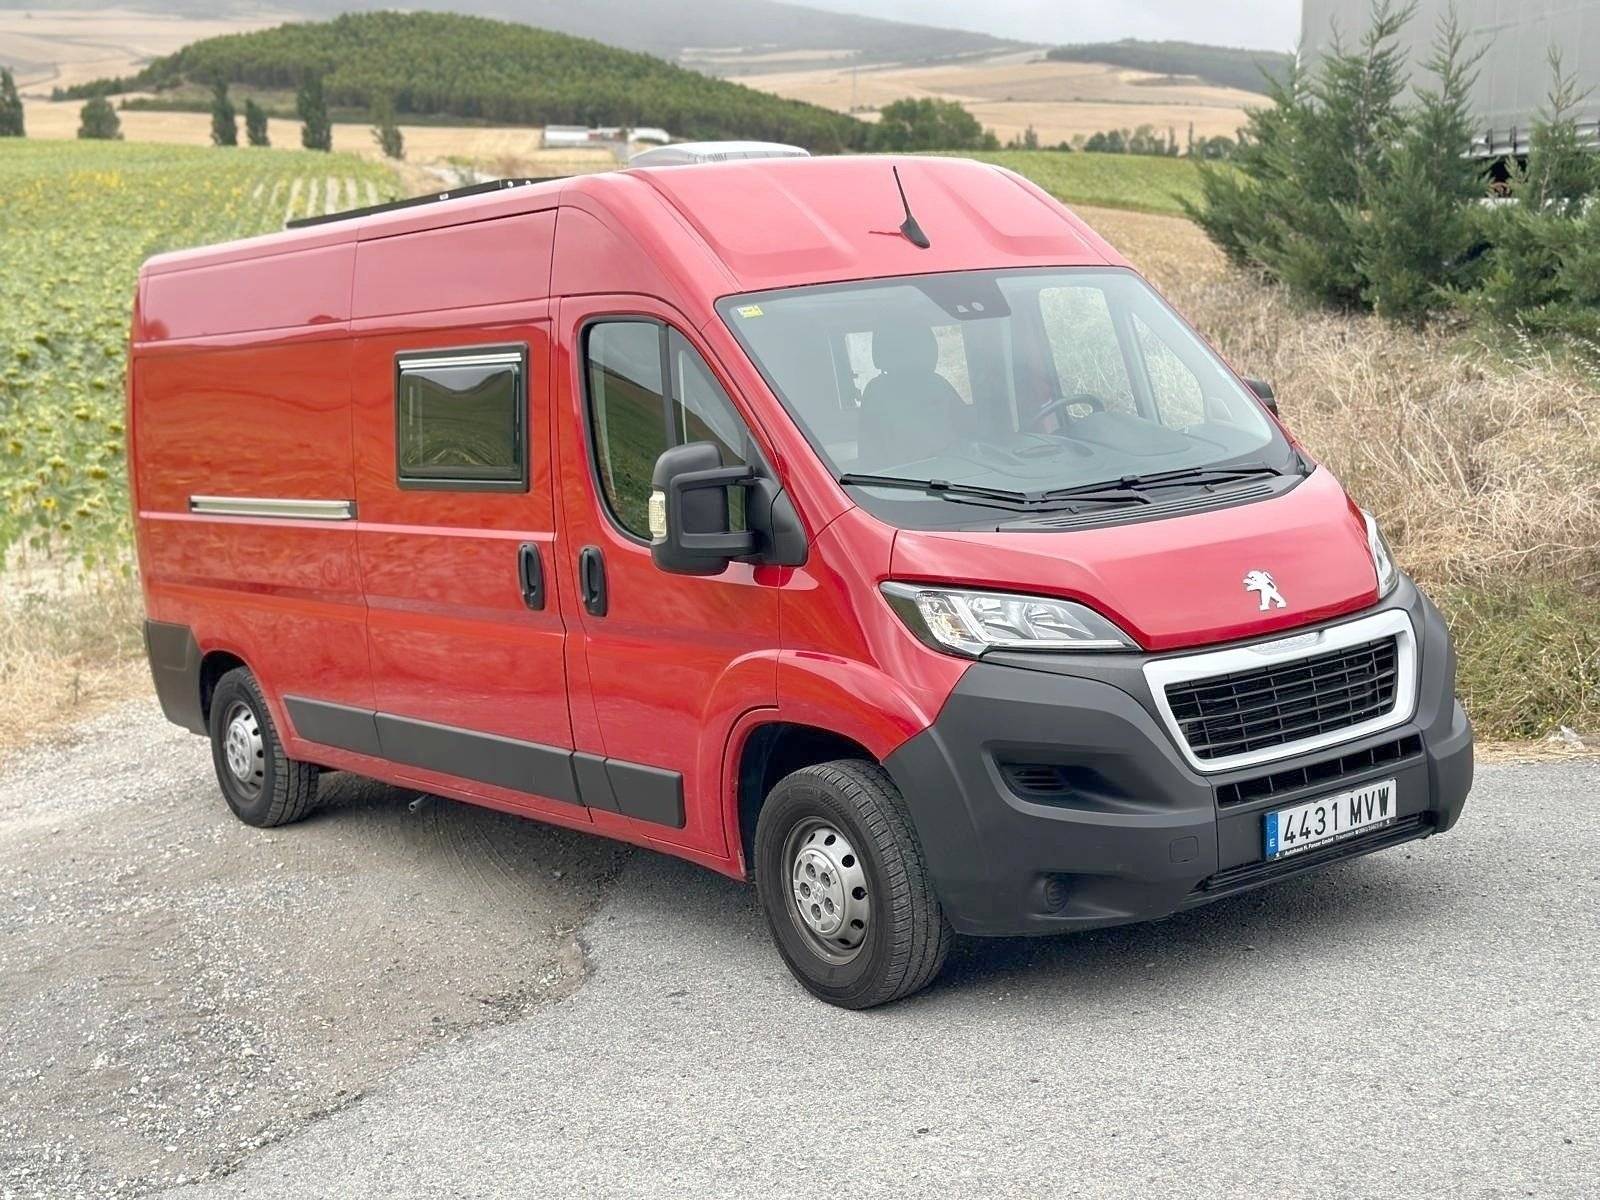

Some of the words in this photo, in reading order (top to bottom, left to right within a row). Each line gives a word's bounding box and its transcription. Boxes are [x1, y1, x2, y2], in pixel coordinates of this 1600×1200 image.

[1283, 802, 1338, 844] 4431
[1349, 787, 1389, 826] MVW
[1269, 838, 1275, 847] E
